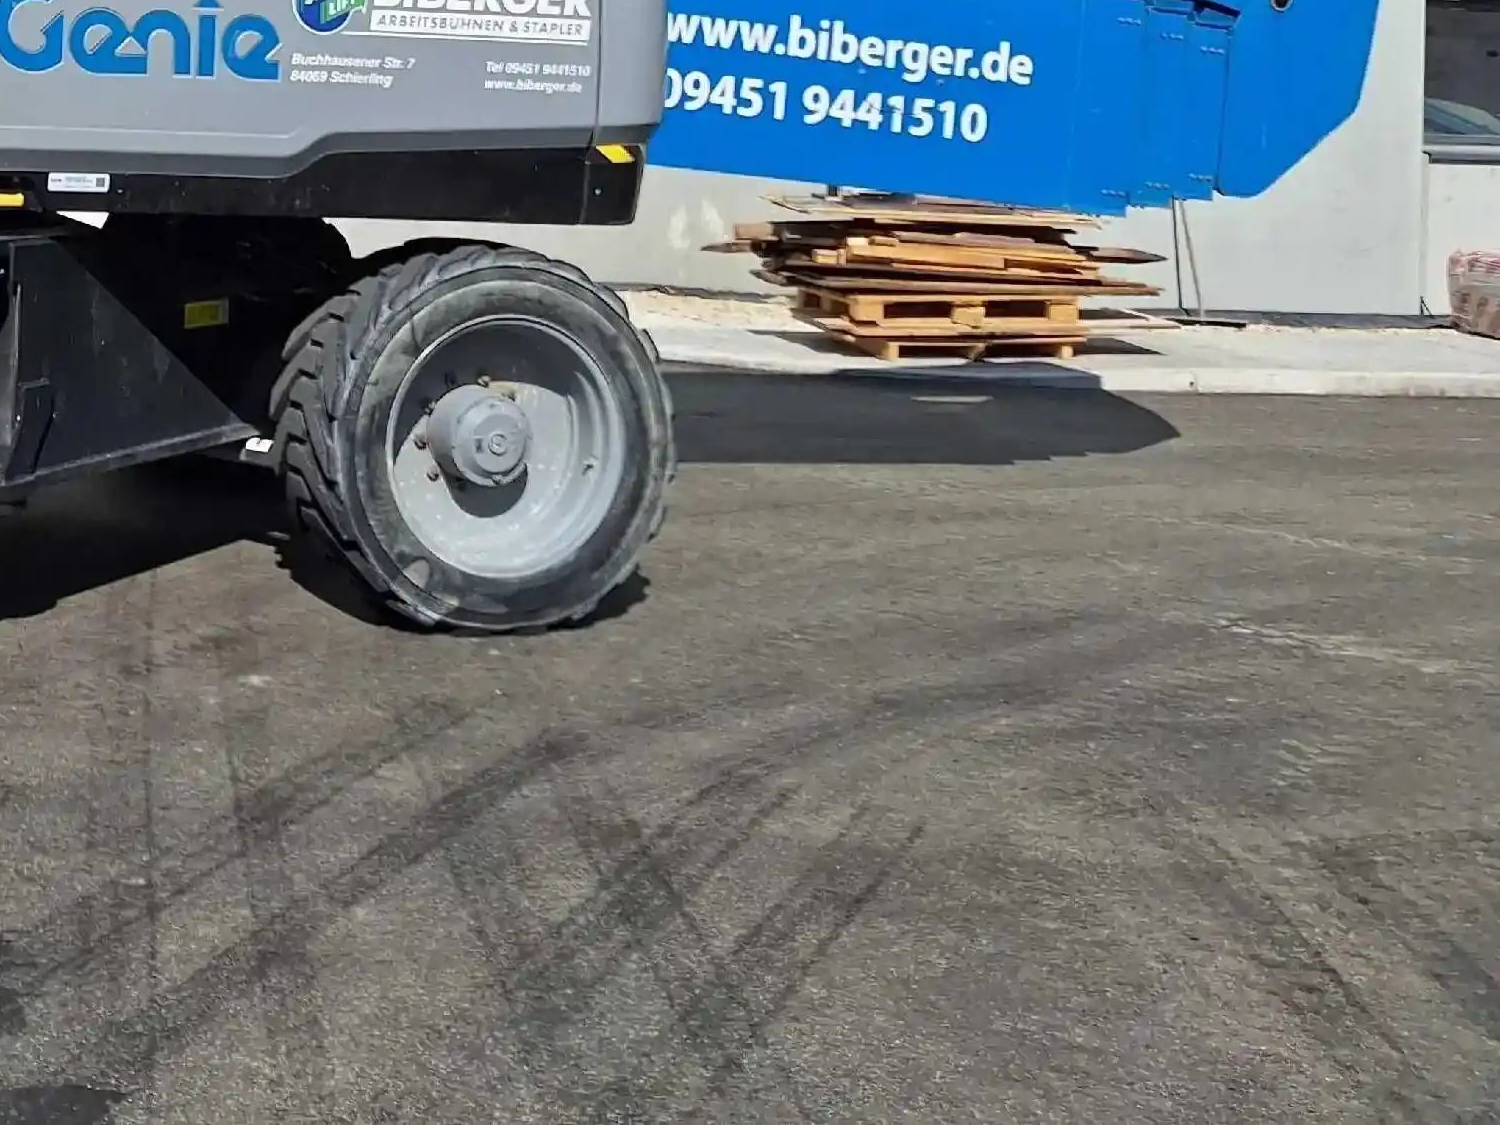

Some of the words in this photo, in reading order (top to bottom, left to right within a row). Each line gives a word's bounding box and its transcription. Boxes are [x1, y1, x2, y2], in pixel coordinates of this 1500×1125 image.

[509, 20, 518, 33] &
[523, 20, 583, 36] STAPLER
[667, 12, 1034, 86] www.biberger.de
[505, 62, 540, 74] 09451
[289, 69, 328, 82] 84069
[329, 70, 394, 88] Schierling
[802, 84, 989, 143] 9441510
